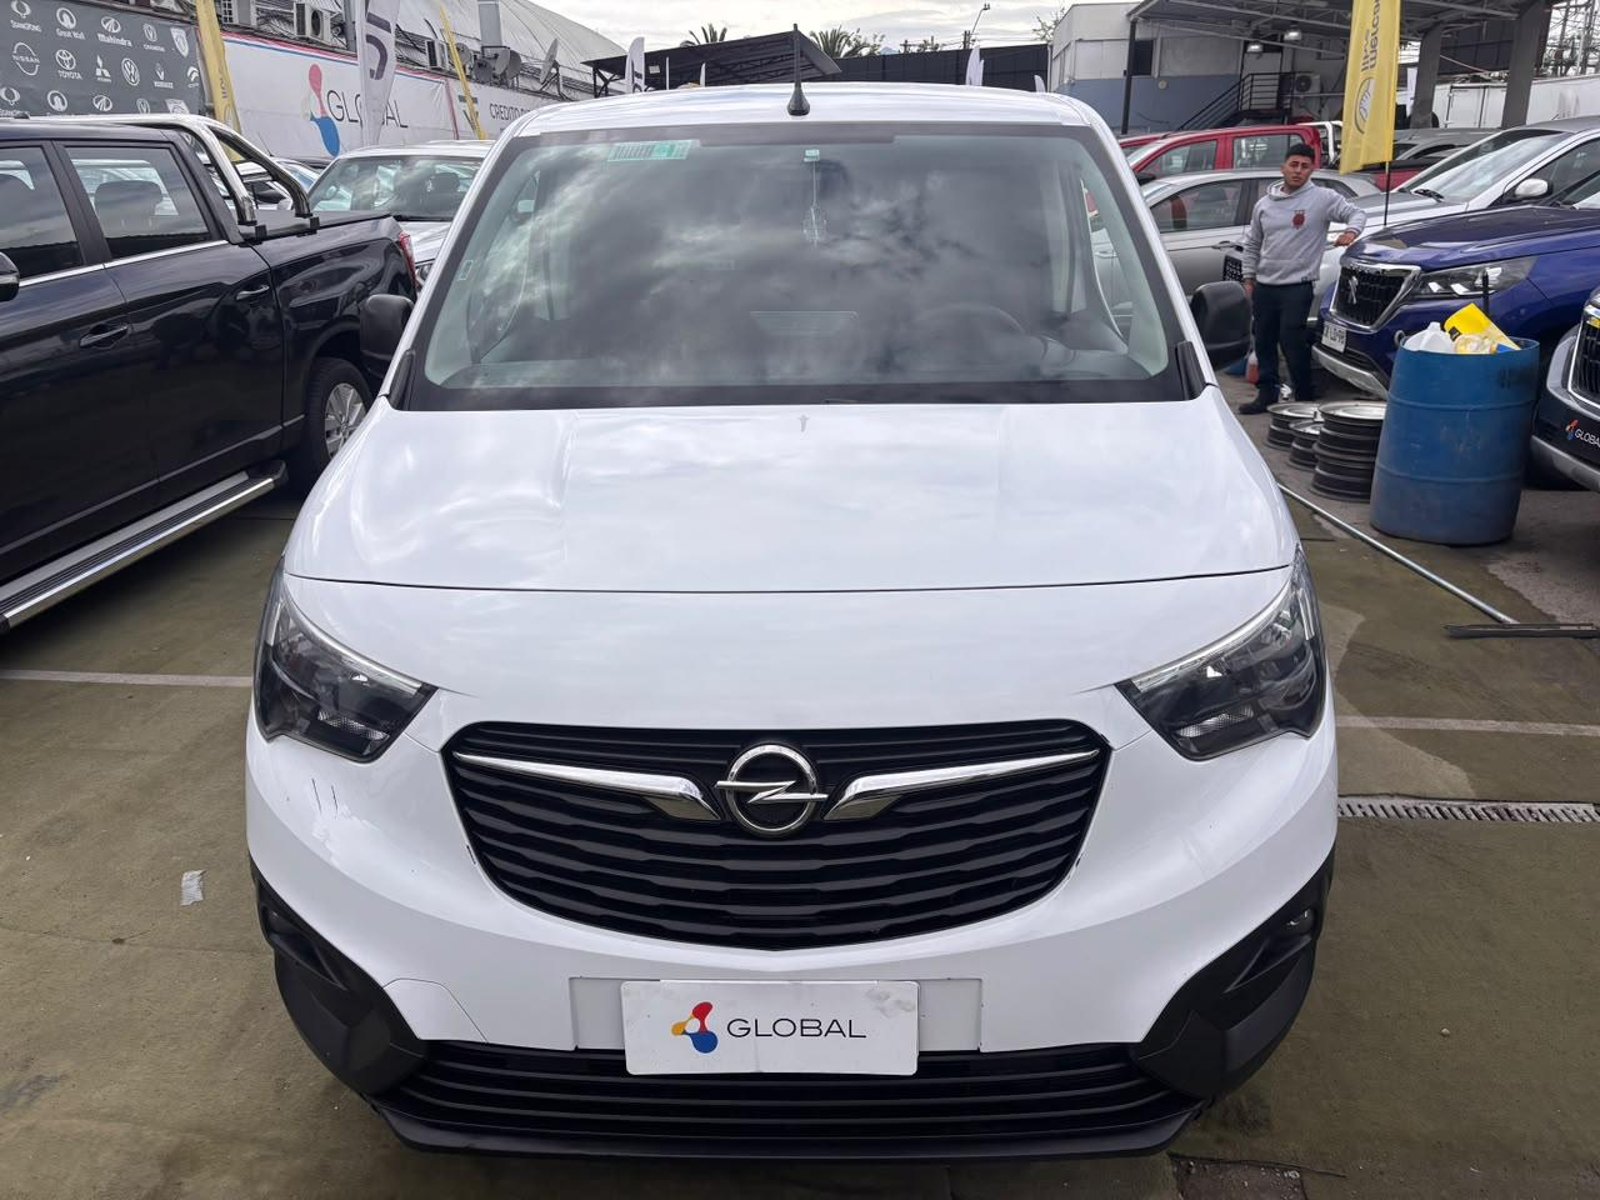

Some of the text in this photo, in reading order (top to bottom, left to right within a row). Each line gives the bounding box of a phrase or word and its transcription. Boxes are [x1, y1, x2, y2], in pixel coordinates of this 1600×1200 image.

[97, 32, 133, 47] Mahindra
[57, 69, 83, 80] TOYOTA
[726, 1018, 867, 1039] GLOBAL
